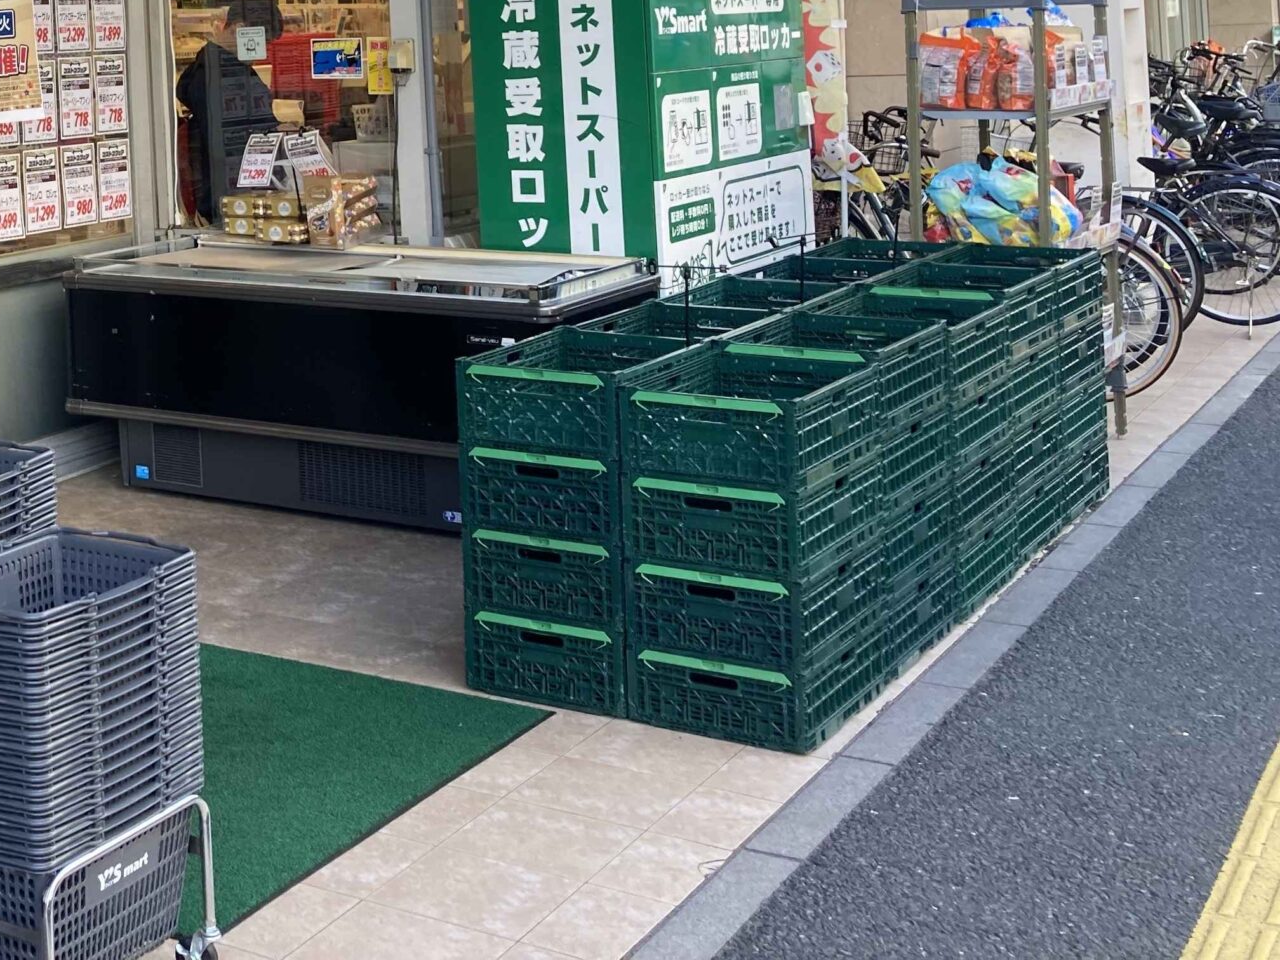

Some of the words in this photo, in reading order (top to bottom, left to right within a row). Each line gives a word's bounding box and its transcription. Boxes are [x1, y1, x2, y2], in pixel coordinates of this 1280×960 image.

[714, 22, 801, 56] 冷蔵受取ロッカー
[74, 111, 89, 128] 718
[108, 107, 123, 124] 718
[569, 3, 608, 252] ネットスーパー
[727, 180, 782, 206] ネットスーパーで
[76, 198, 93, 216] 980
[727, 203, 777, 231] 購入した商品を
[123, 851, 149, 878] mart
